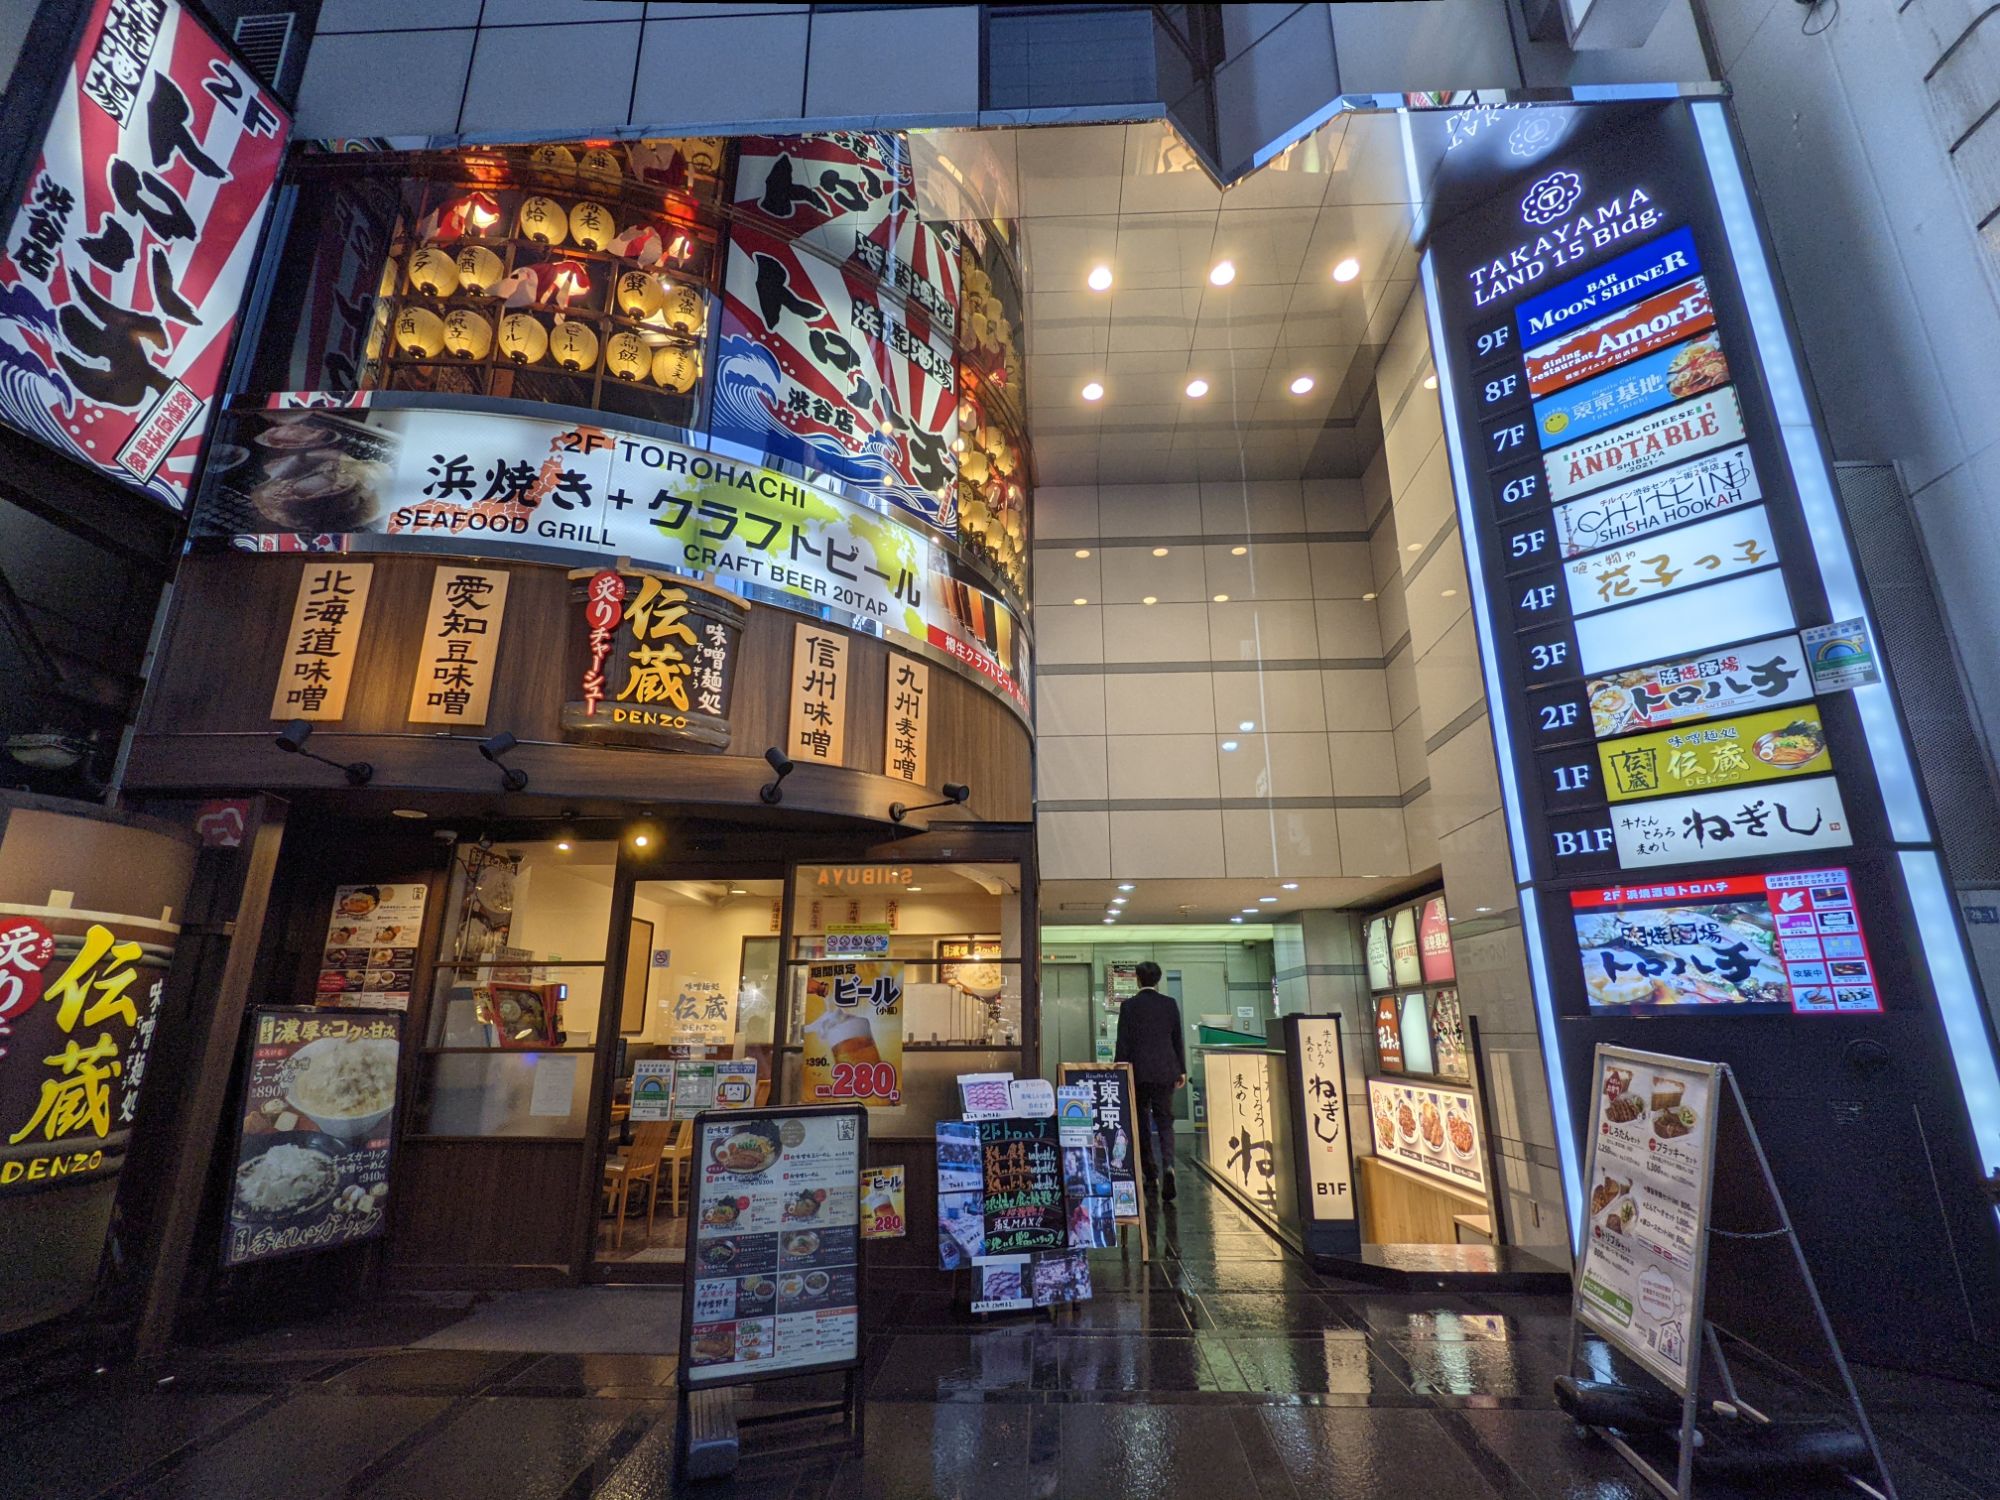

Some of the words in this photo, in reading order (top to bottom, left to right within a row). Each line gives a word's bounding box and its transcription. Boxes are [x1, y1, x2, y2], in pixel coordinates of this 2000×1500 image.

[202, 58, 280, 138] 2F
[12, 172, 76, 284] 渋谷店
[54, 70, 232, 409] トロハチ
[1469, 188, 1650, 288] TAKAYAMA
[1473, 260, 1545, 307] LAND
[1554, 240, 1585, 268] 15
[1592, 208, 1664, 250] Bldg.
[1586, 272, 1618, 294] BAR
[1528, 297, 1598, 336] MOON
[1477, 325, 1510, 356] 9F
[1646, 330, 1679, 348] アモーレ
[753, 253, 956, 494] トロハチ
[1531, 350, 1595, 383] restaurant
[1543, 349, 1582, 371] dining
[1484, 374, 1518, 402] 8F
[1570, 373, 1665, 421] 東京基地
[787, 387, 855, 433] 渋谷店
[1493, 424, 1525, 452] 7F
[1567, 412, 1720, 485] ANDTABLE
[564, 431, 606, 455] 2F
[620, 439, 807, 509] TOROHACHI
[1616, 450, 1666, 471] SHIBUYA
[1502, 475, 1537, 504] 6F
[422, 454, 593, 510] 浜焼き
[648, 488, 921, 608] クラフトビール
[1599, 516, 1661, 543] SHISHA
[1664, 488, 1742, 524] HOOKAH
[1511, 529, 1546, 558] 5F
[395, 507, 529, 535] SEAFOOD
[537, 519, 617, 547] GRILL
[683, 543, 764, 577] CRAFT
[770, 565, 828, 597] BEER
[833, 584, 889, 618] 20TAP
[1520, 585, 1556, 612] 4F
[286, 569, 356, 712] 北海道味噌
[426, 574, 494, 716] 愛知豆味噌
[583, 575, 619, 716] 炙りチャーシュー
[616, 575, 698, 712] 伝蔵
[1531, 641, 1567, 672] 3F
[691, 642, 704, 690] でんぞう
[697, 623, 728, 715] 味噌麺処
[945, 634, 1014, 693] 樽生クラフトビール
[1659, 654, 1740, 687] 浜焼酒場
[800, 636, 841, 758] 信州味噌
[1629, 655, 1800, 720] トロハチ
[613, 708, 688, 729] DENZO
[893, 664, 924, 781] 九州麦味噌
[1539, 702, 1578, 731] 2F
[1667, 726, 1740, 749] 味噌麺処
[1552, 764, 1592, 792] 1F
[1622, 753, 1650, 790] 伝蔵
[1667, 742, 1751, 780] 伝蔵
[1685, 771, 1741, 787] DENZO
[1620, 815, 1660, 830] 牛たん
[1643, 824, 1676, 839] とろろ
[1682, 799, 1823, 849] ねぎし
[1555, 825, 1615, 857] B1F
[1637, 840, 1670, 856] 麦めし
[1601, 890, 1622, 902] 2F
[1626, 880, 1729, 901] 浜焼酒場トロハチ
[811, 964, 856, 978] 期間限定
[1600, 941, 1762, 984] トロハチ
[1793, 969, 1823, 978] 改装中
[673, 993, 728, 1021] 伝蔵
[833, 976, 901, 1006] ビール
[9, 923, 143, 1145] 伝蔵
[275, 1017, 396, 1044] 濃厚なコクと甘み
[1322, 1029, 1333, 1055] 牛たん
[1305, 1035, 1314, 1062] 麦めし
[1316, 1042, 1326, 1068] とろろ
[1098, 1079, 1122, 1130] 東京
[1233, 1073, 1248, 1117] 麦めし
[1252, 1083, 1265, 1128] とろろ
[1308, 1073, 1340, 1144] ねぎし
[1, 1150, 104, 1185] DENZO
[873, 1175, 902, 1190] ビール
[1316, 1182, 1347, 1196] B1F
